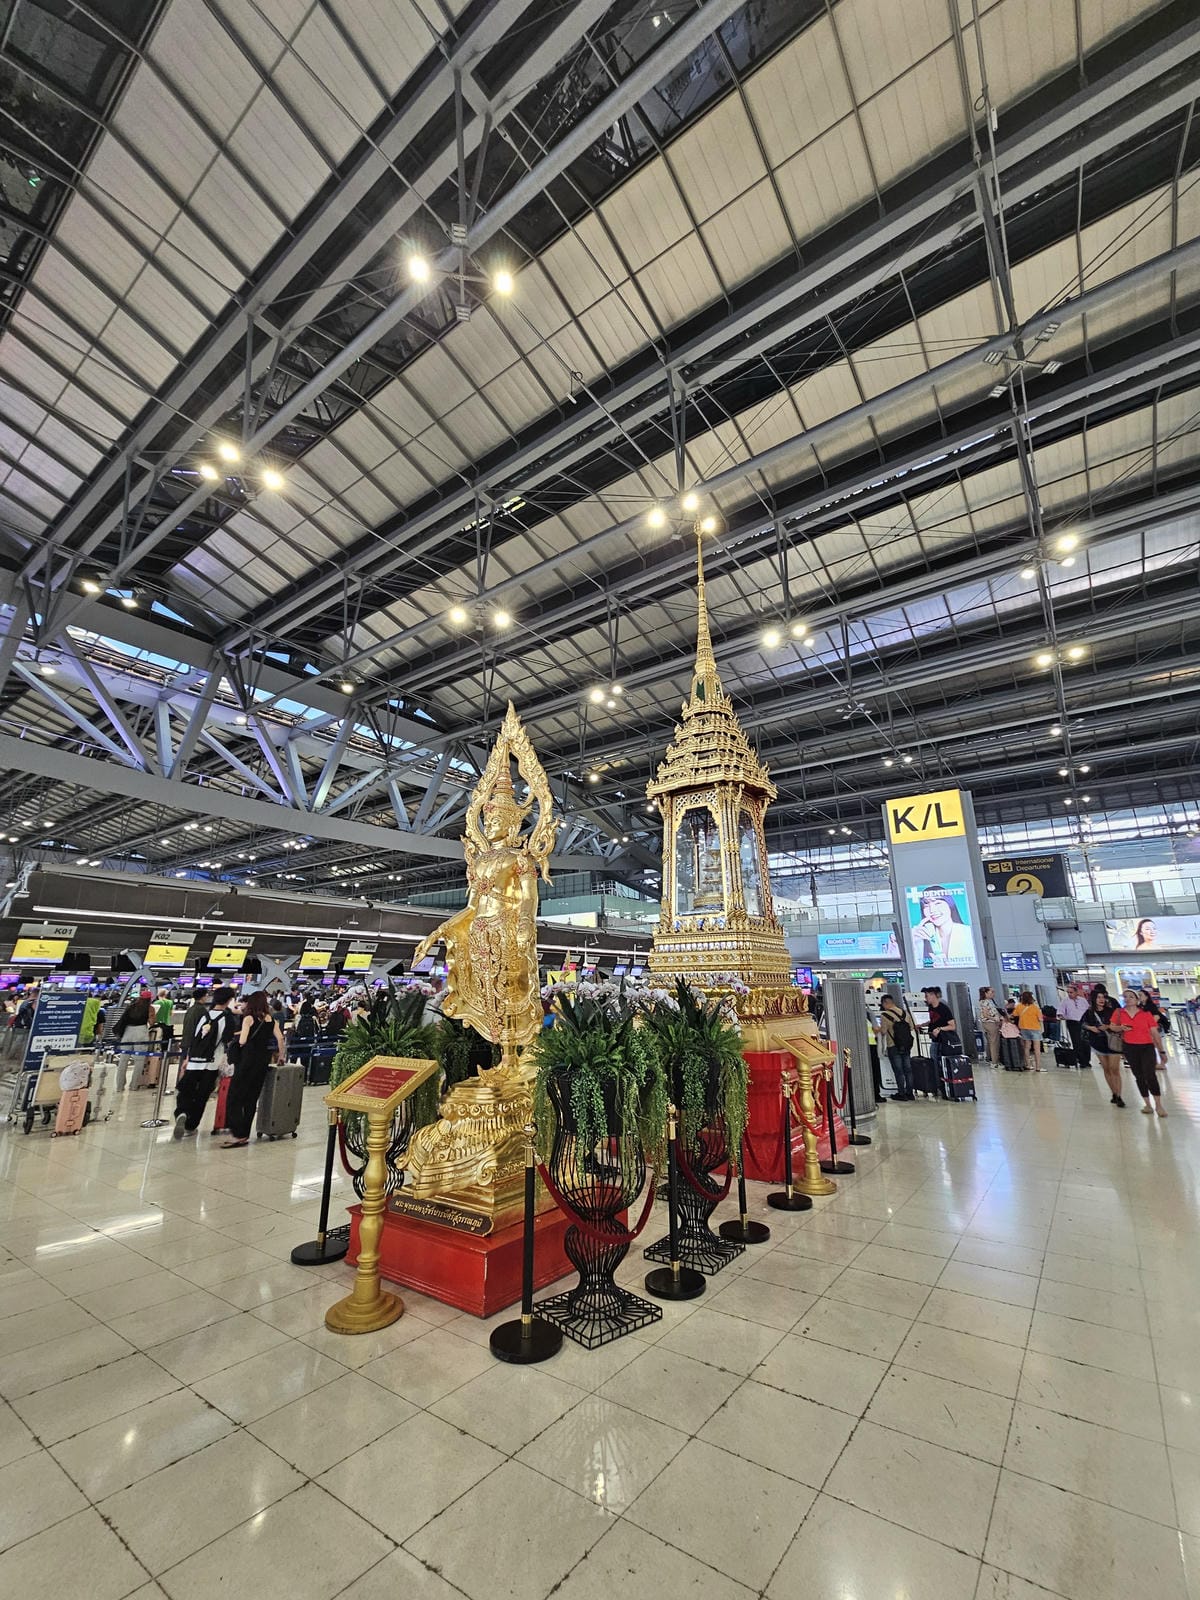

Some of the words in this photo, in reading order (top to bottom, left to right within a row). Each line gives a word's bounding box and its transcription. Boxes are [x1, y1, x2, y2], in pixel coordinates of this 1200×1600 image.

[892, 802, 958, 834] K/L
[1015, 857, 1054, 865] International
[1016, 864, 1051, 872] Departures
[1016, 878, 1033, 895] 2
[54, 927, 73, 935] K01
[153, 932, 171, 940] K02
